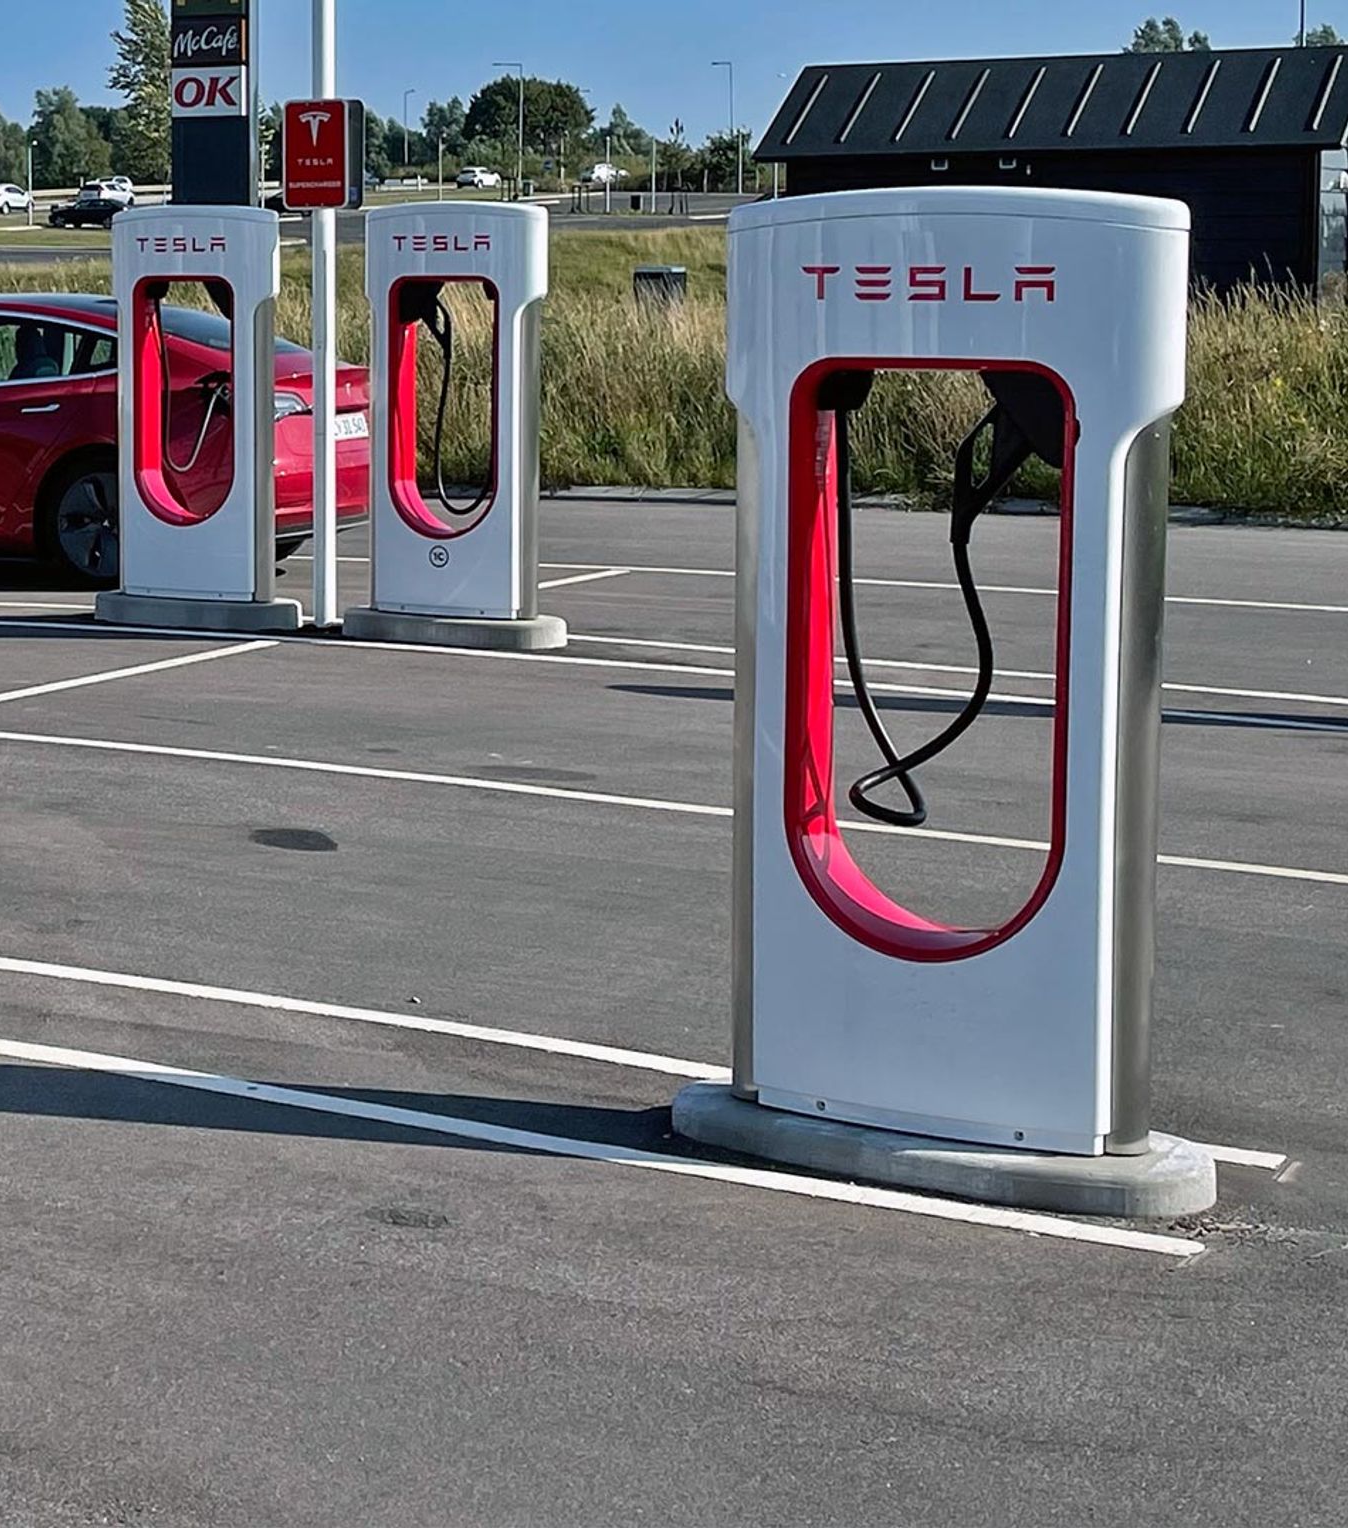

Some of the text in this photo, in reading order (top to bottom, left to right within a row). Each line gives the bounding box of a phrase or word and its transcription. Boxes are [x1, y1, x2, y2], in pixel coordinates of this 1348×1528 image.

[173, 26, 239, 57] McCafé
[174, 76, 239, 108] OK
[296, 158, 334, 166] TESLA
[135, 236, 226, 253] TESLA
[392, 235, 491, 252] TESLA
[801, 266, 1056, 302] TESLA
[433, 552, 445, 562] 1C
